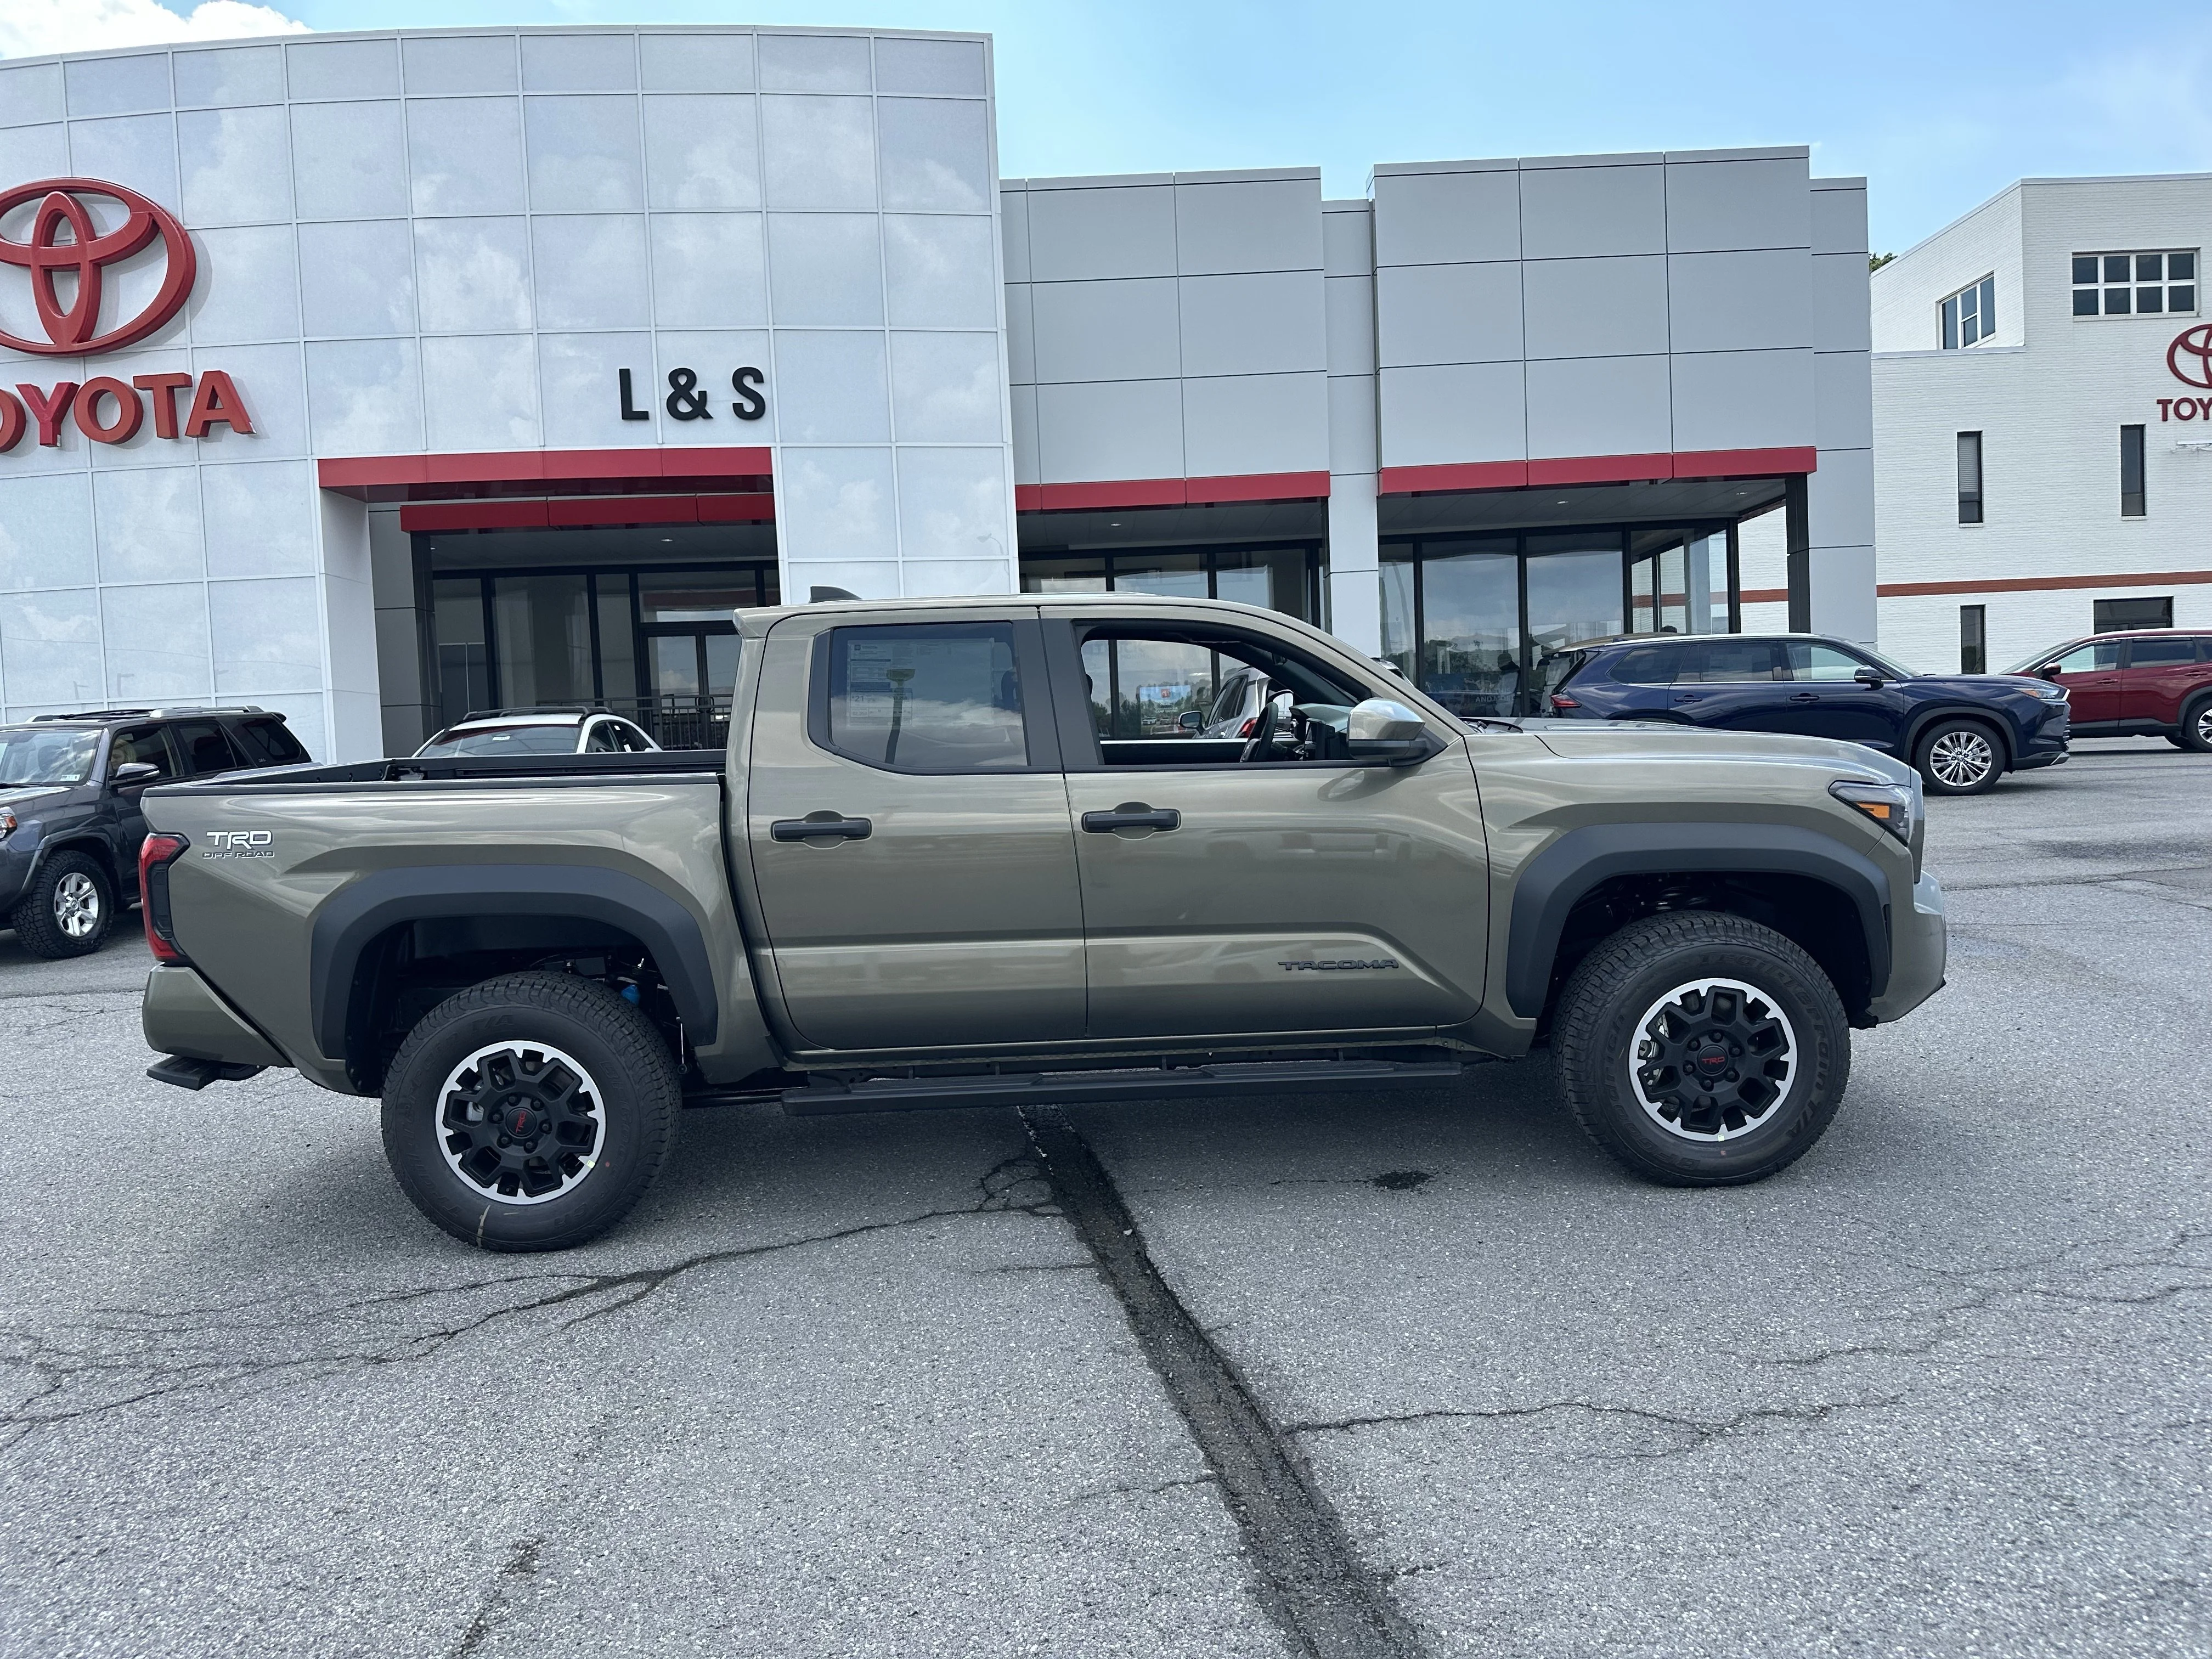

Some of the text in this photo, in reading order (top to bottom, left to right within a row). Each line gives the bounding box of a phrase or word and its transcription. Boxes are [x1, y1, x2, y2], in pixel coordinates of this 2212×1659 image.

[619, 366, 766, 420] L & S
[206, 830, 272, 850] TRD
[234, 850, 275, 859] ROAD
[1278, 959, 1399, 970] TACOMA
[1701, 1056, 1725, 1065] TRD
[515, 1110, 527, 1133] TRD
